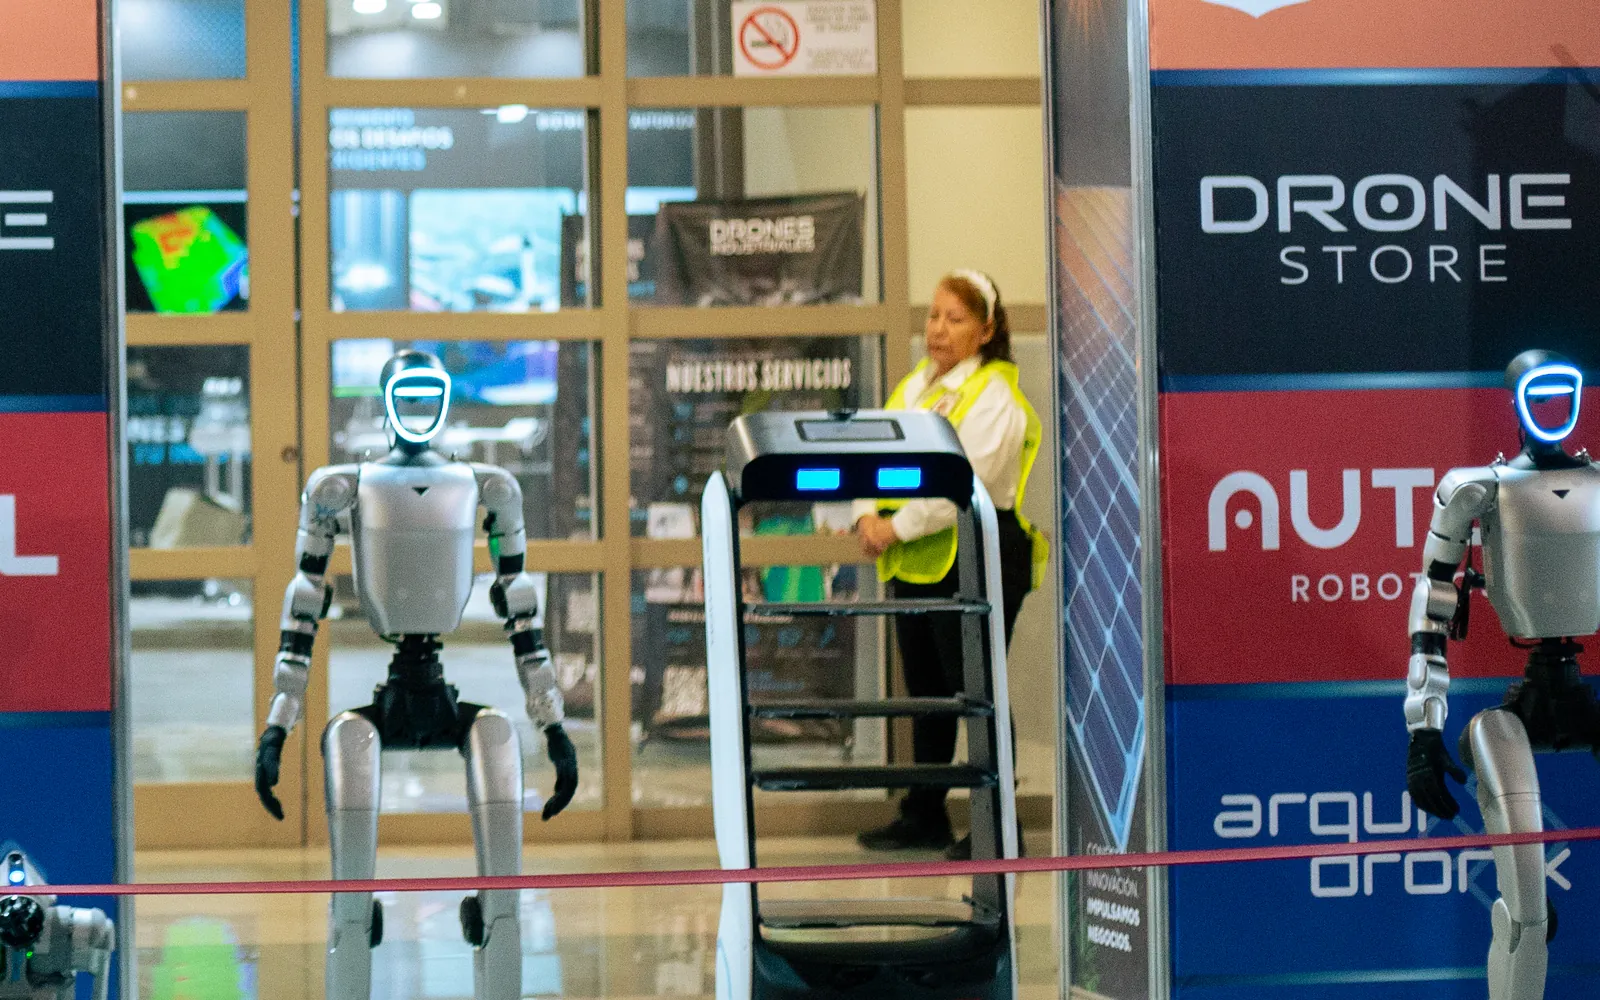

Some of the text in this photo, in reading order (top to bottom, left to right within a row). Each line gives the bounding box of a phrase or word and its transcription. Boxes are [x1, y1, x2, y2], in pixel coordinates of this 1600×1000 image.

[328, 127, 360, 150] OS
[1200, 174, 1572, 234] DRONE
[709, 216, 815, 241] DRONES
[1279, 244, 1508, 285] STORE
[666, 357, 851, 392] NUESTROS SERVICIOS
[1207, 468, 1484, 552] AUT
[1086, 897, 1140, 927] IMPULSAMOS
